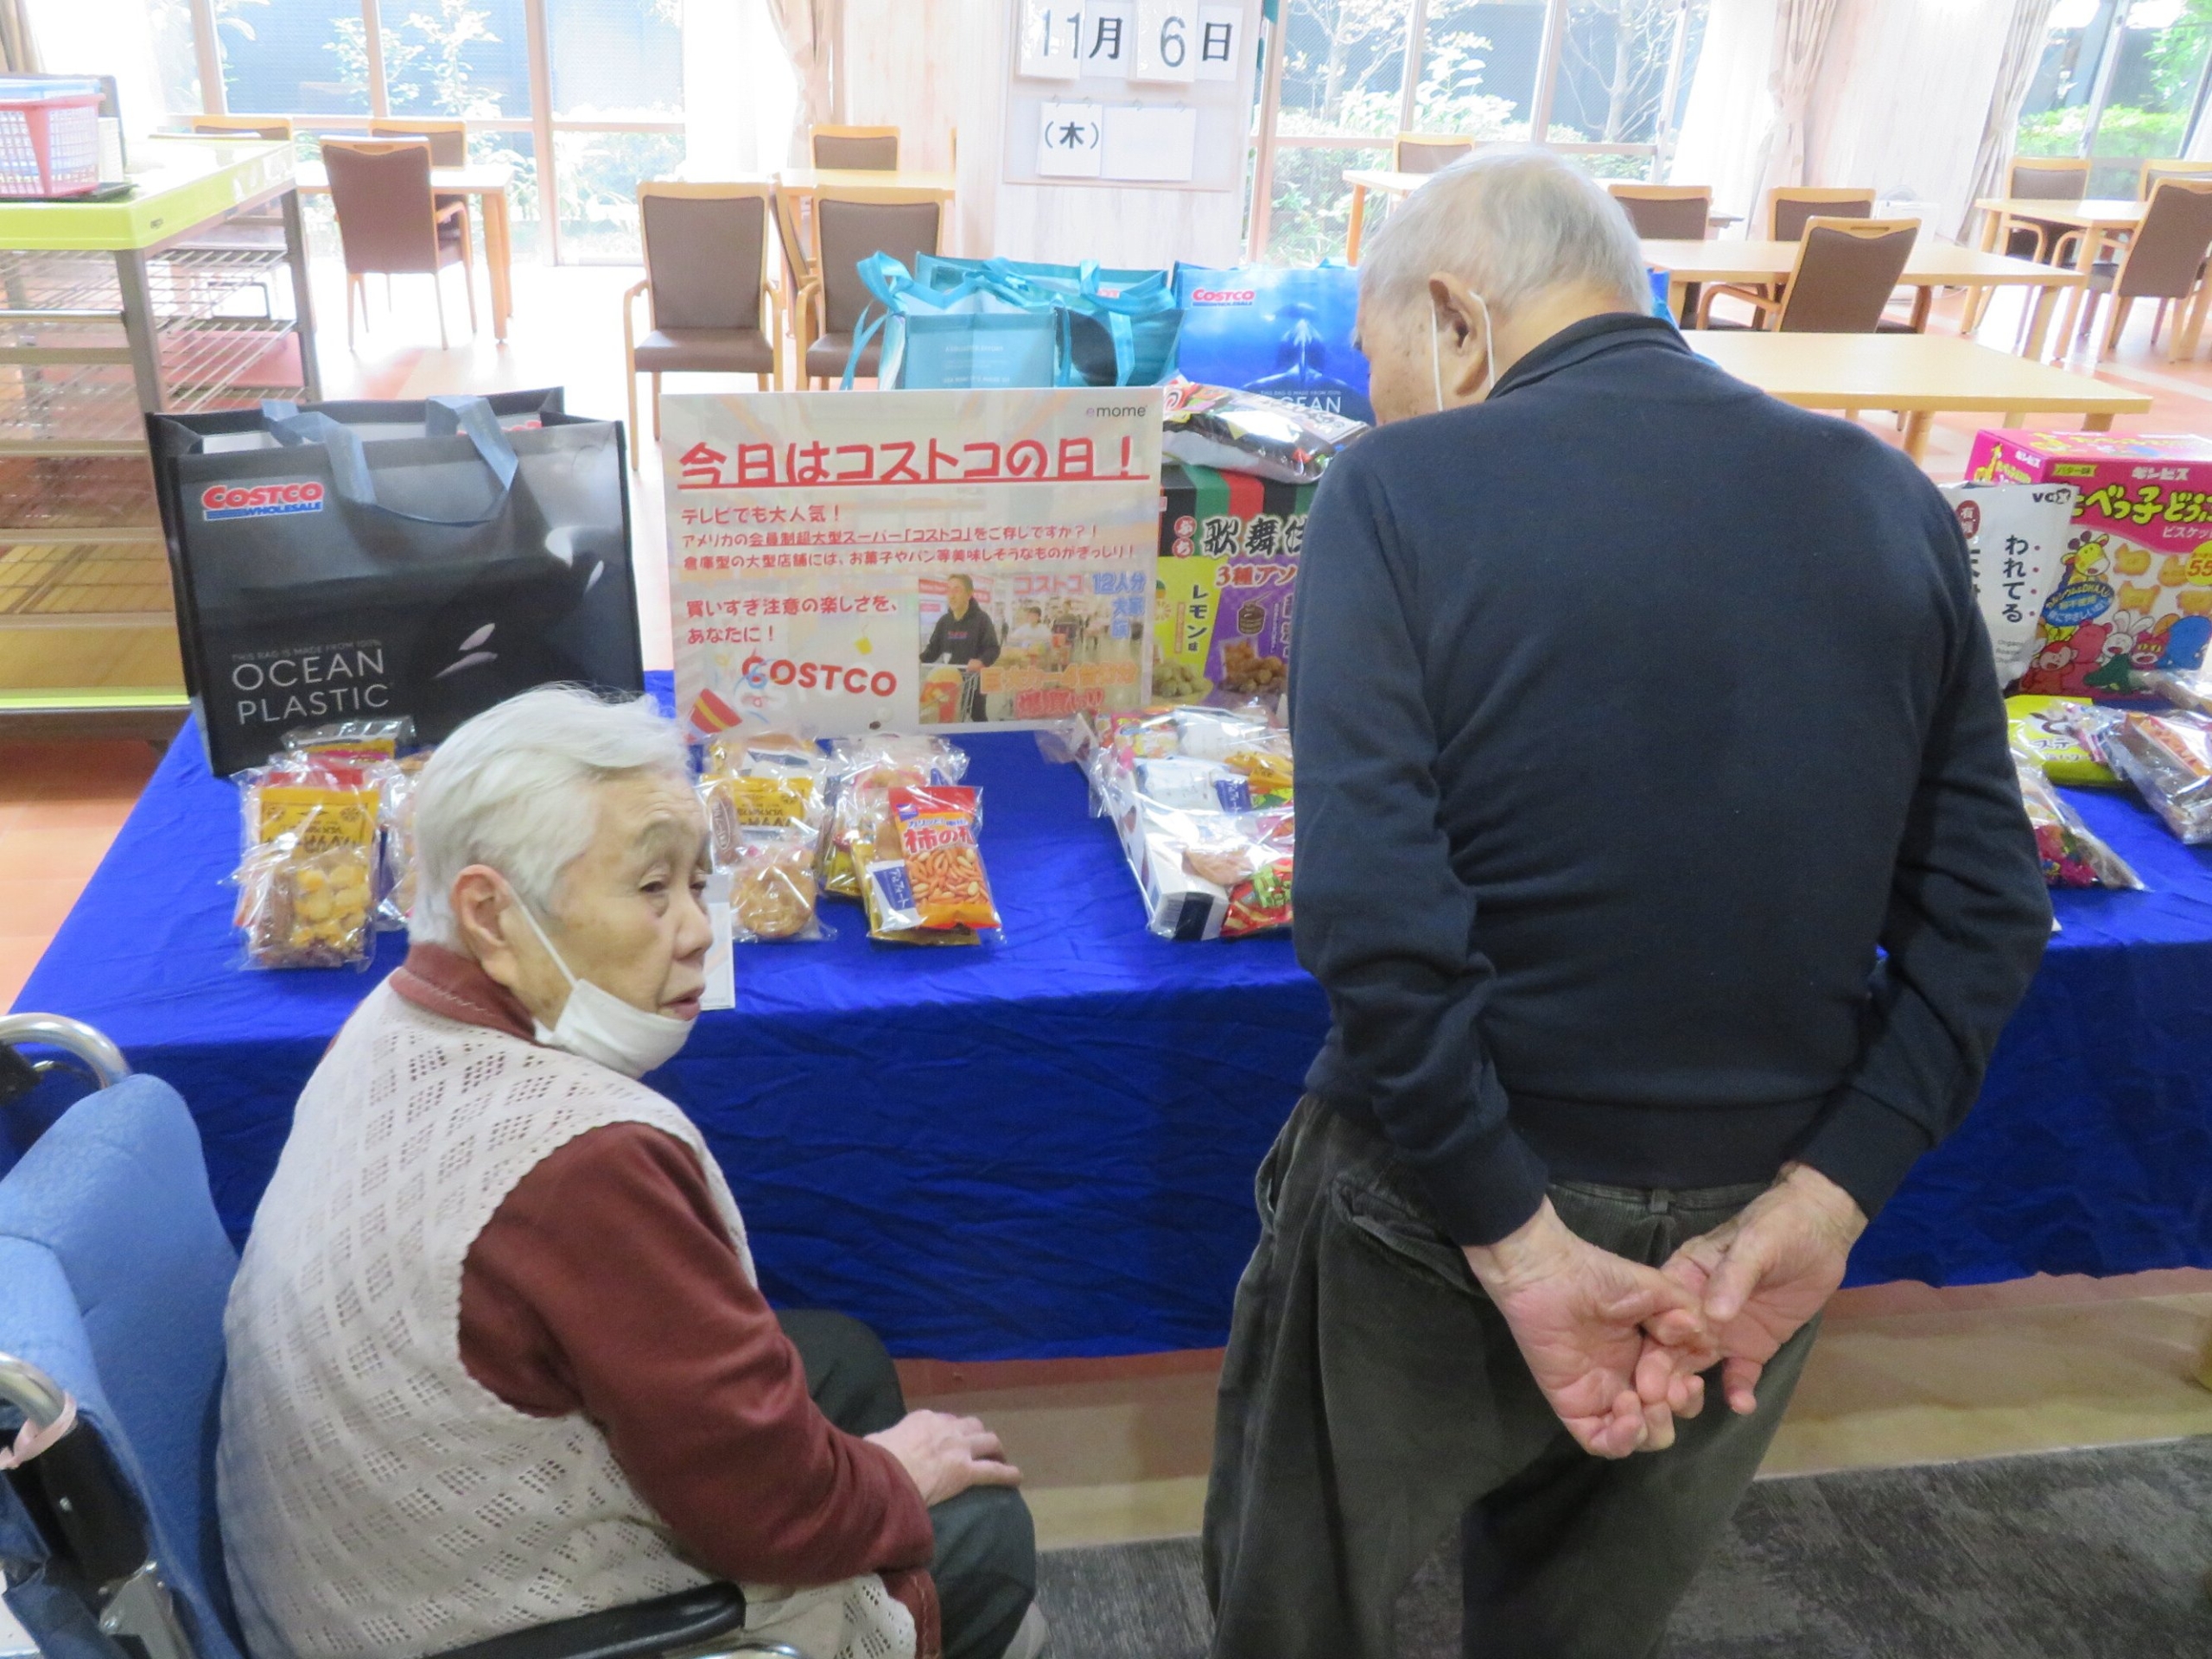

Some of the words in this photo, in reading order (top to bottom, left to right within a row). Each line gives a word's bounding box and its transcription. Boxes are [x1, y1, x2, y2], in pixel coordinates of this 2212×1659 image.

[1042, 9, 1123, 60] 11月
[1160, 16, 1233, 67] 6日
[1045, 120, 1100, 149] (木)
[1192, 288, 1255, 302] COSTCO
[1086, 406, 1147, 417] emome
[679, 435, 1131, 487] 今日はコストコの日！
[202, 481, 324, 510] COSTCO
[245, 501, 322, 516] WHOLESALE
[2073, 484, 2212, 525] べっ子どう
[682, 505, 840, 525] テレビでも大人気！
[1013, 574, 1084, 595] コストコ
[2002, 534, 2030, 623] われてる
[686, 595, 898, 619] 買いすぎ注意の楽しさを、
[1187, 584, 1209, 652] レモン味
[688, 625, 775, 645] あなたに！
[232, 648, 385, 691] OCEAN
[741, 654, 898, 697] COSTCO
[238, 683, 389, 725] PLASTIC
